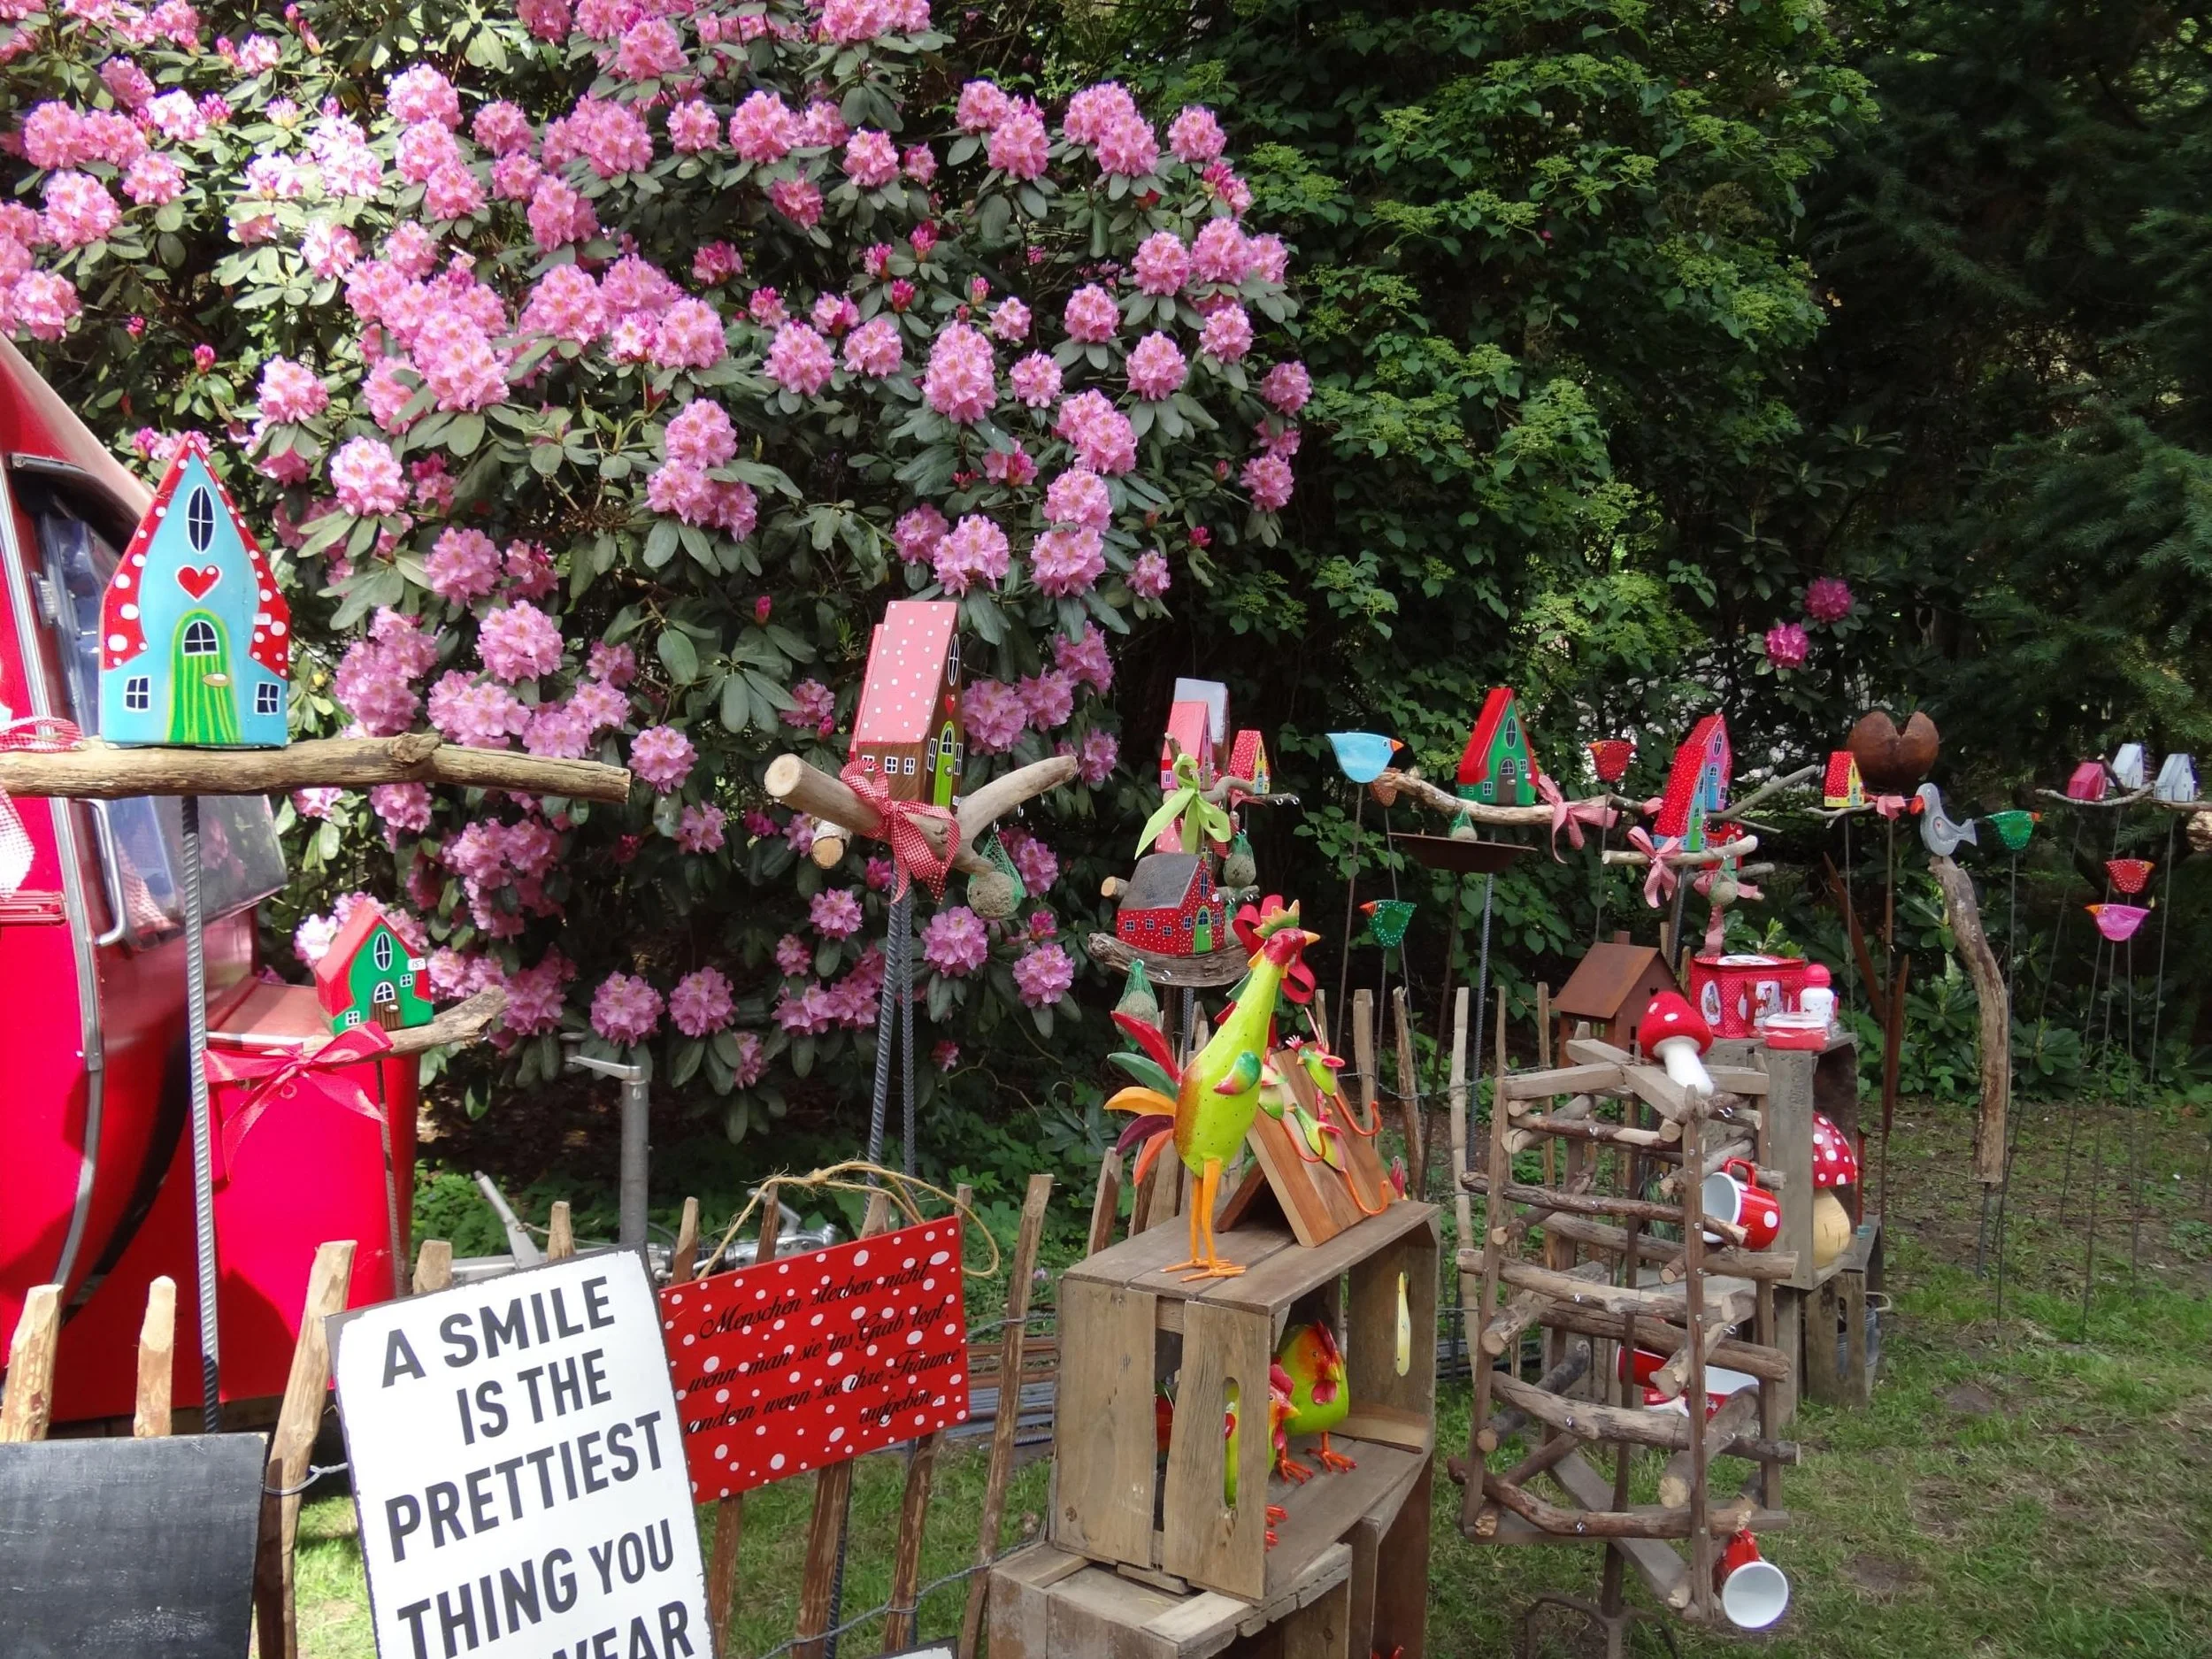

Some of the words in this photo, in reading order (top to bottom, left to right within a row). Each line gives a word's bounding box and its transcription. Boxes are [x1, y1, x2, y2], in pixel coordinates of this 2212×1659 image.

[382, 1328, 426, 1388] A
[440, 1276, 615, 1368] SMILE
[700, 1295, 802, 1339] Menschen
[809, 1275, 874, 1306] sterben
[881, 1256, 931, 1288] nicht
[457, 1380, 509, 1446] IS
[517, 1348, 612, 1424] THE
[683, 1402, 757, 1437] sondern
[763, 1390, 811, 1415] wenn
[817, 1377, 845, 1400] sie
[848, 1365, 885, 1390] ihre
[888, 1348, 962, 1379] Träume
[687, 1367, 738, 1394] wenn
[746, 1351, 792, 1378] man
[797, 1338, 823, 1362] sie
[826, 1331, 853, 1353] ins
[854, 1309, 903, 1352] Grab
[385, 1410, 662, 1563] PRETTIEST
[396, 1548, 579, 1659] THING
[588, 1518, 674, 1595] YOU
